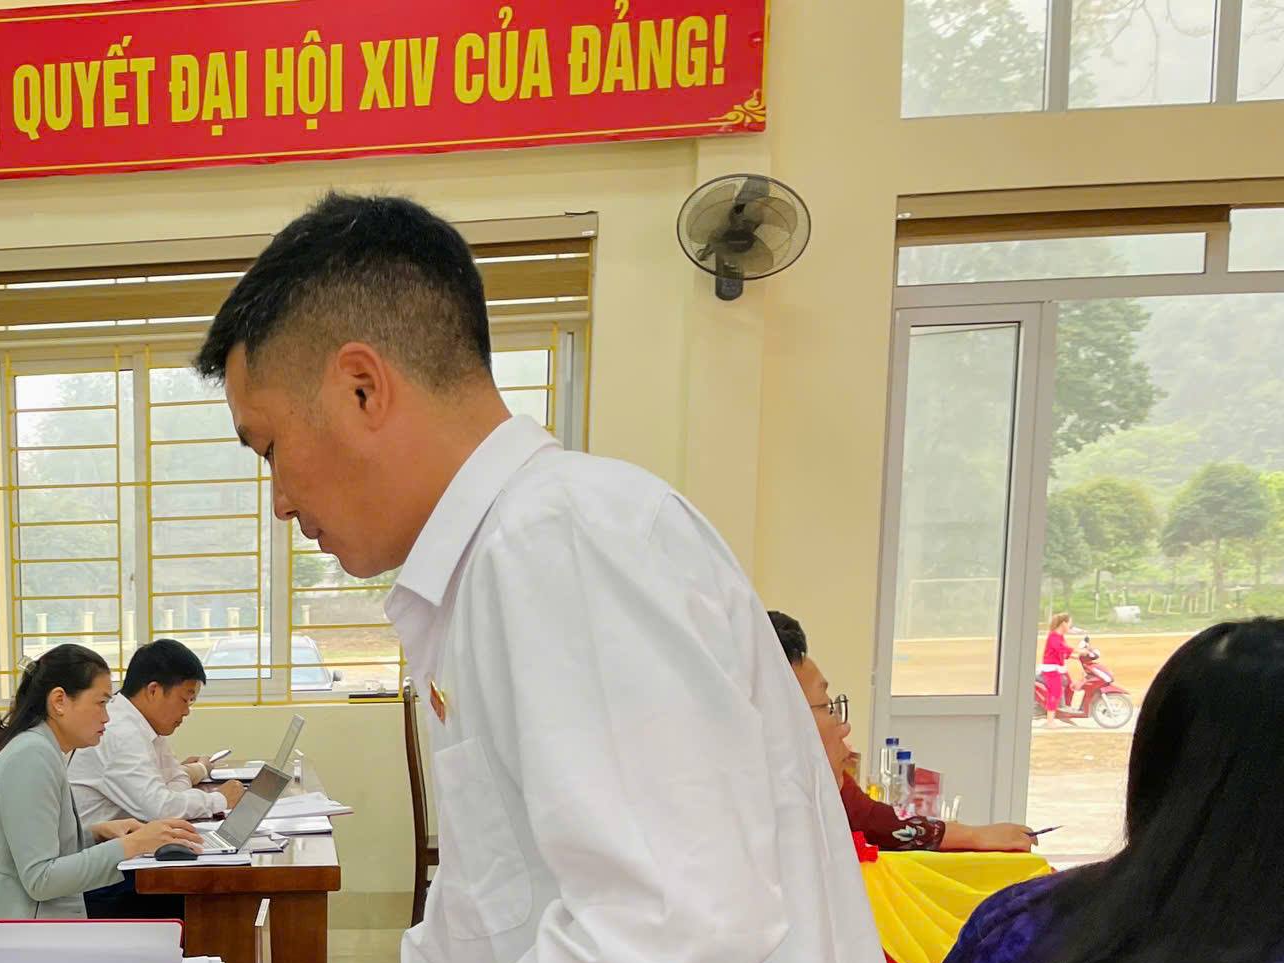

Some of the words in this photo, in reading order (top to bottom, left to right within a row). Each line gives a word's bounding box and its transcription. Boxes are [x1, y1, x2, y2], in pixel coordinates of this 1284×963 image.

[12, 35, 156, 141] QUYẾT
[169, 50, 248, 137] ĐẠI
[264, 29, 343, 130] HỘI
[359, 36, 439, 111] XIV
[454, 6, 553, 104] CỦA
[567, 0, 727, 96] ĐẢNG!
